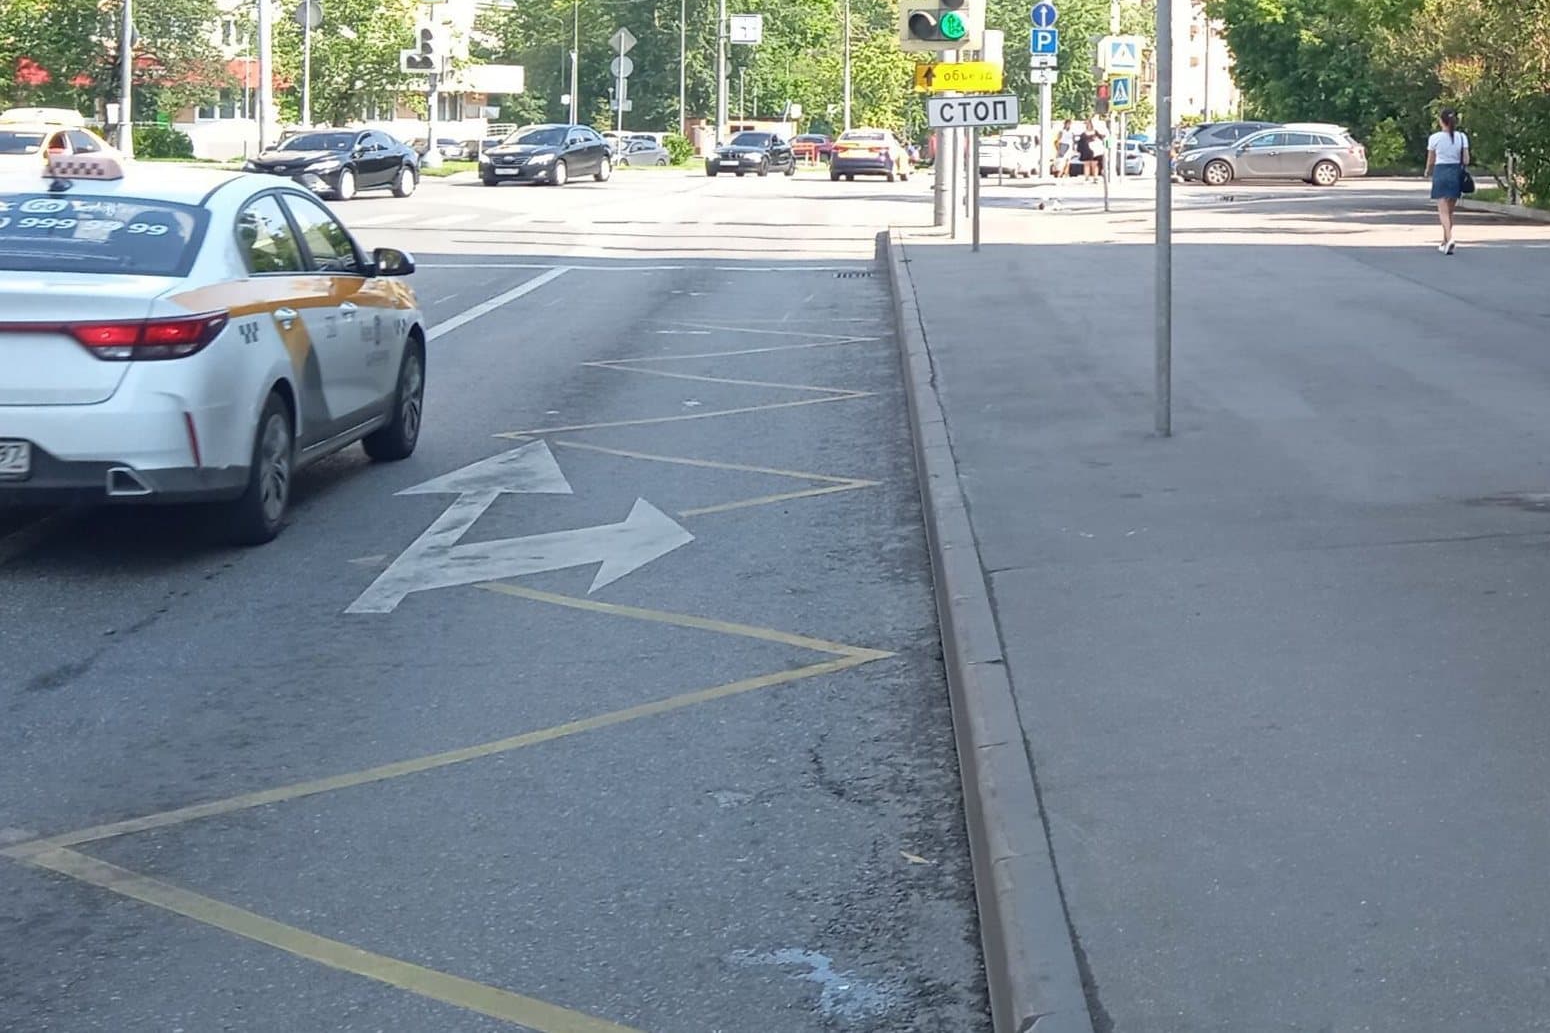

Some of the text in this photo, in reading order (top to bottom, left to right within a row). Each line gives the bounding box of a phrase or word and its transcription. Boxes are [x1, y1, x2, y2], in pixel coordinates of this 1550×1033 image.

[1037, 32, 1052, 51] P
[939, 100, 1007, 123] СТОП
[127, 222, 169, 236] 99
